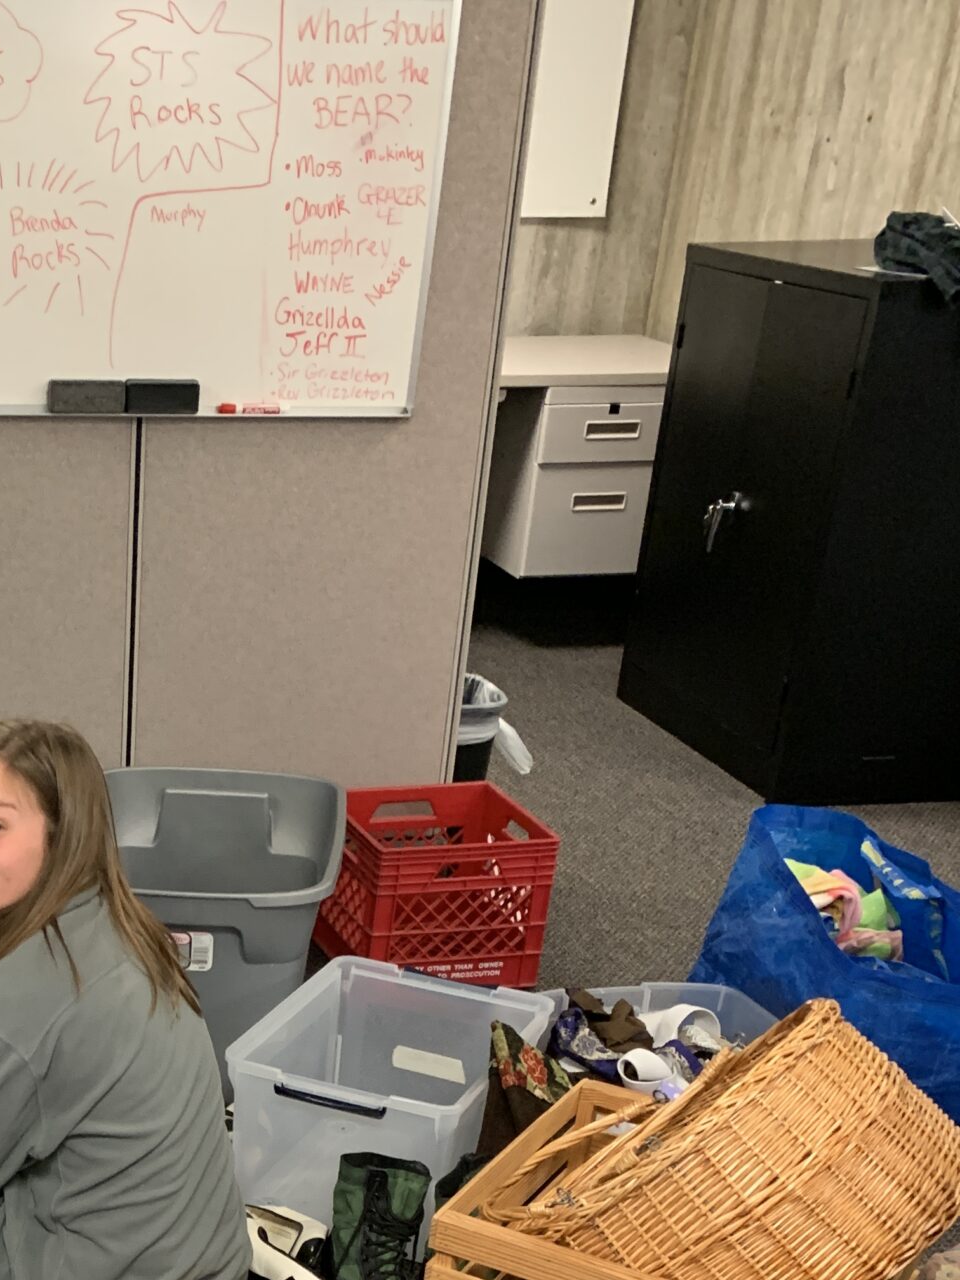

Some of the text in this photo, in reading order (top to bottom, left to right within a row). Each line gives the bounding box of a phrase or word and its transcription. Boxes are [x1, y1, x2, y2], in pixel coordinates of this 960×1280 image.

[298, 6, 446, 46] What should
[130, 46, 200, 87] STS
[287, 56, 429, 87] we name the
[130, 95, 222, 130] Rocks
[312, 93, 413, 129] BEAR?
[296, 154, 343, 178] Moss
[10, 206, 78, 236] Brenda
[150, 203, 206, 232] Murphy
[12, 240, 81, 279] Rocks
[288, 226, 391, 269] Humphrey
[294, 271, 355, 294] WAYNE
[364, 255, 412, 307] Nessie
[279, 331, 339, 358] Jeff
[277, 362, 300, 383] Sir
[427, 964, 452, 972] OTHER
[478, 961, 504, 969] OWNER
[450, 969, 501, 979] PROSECUTION
